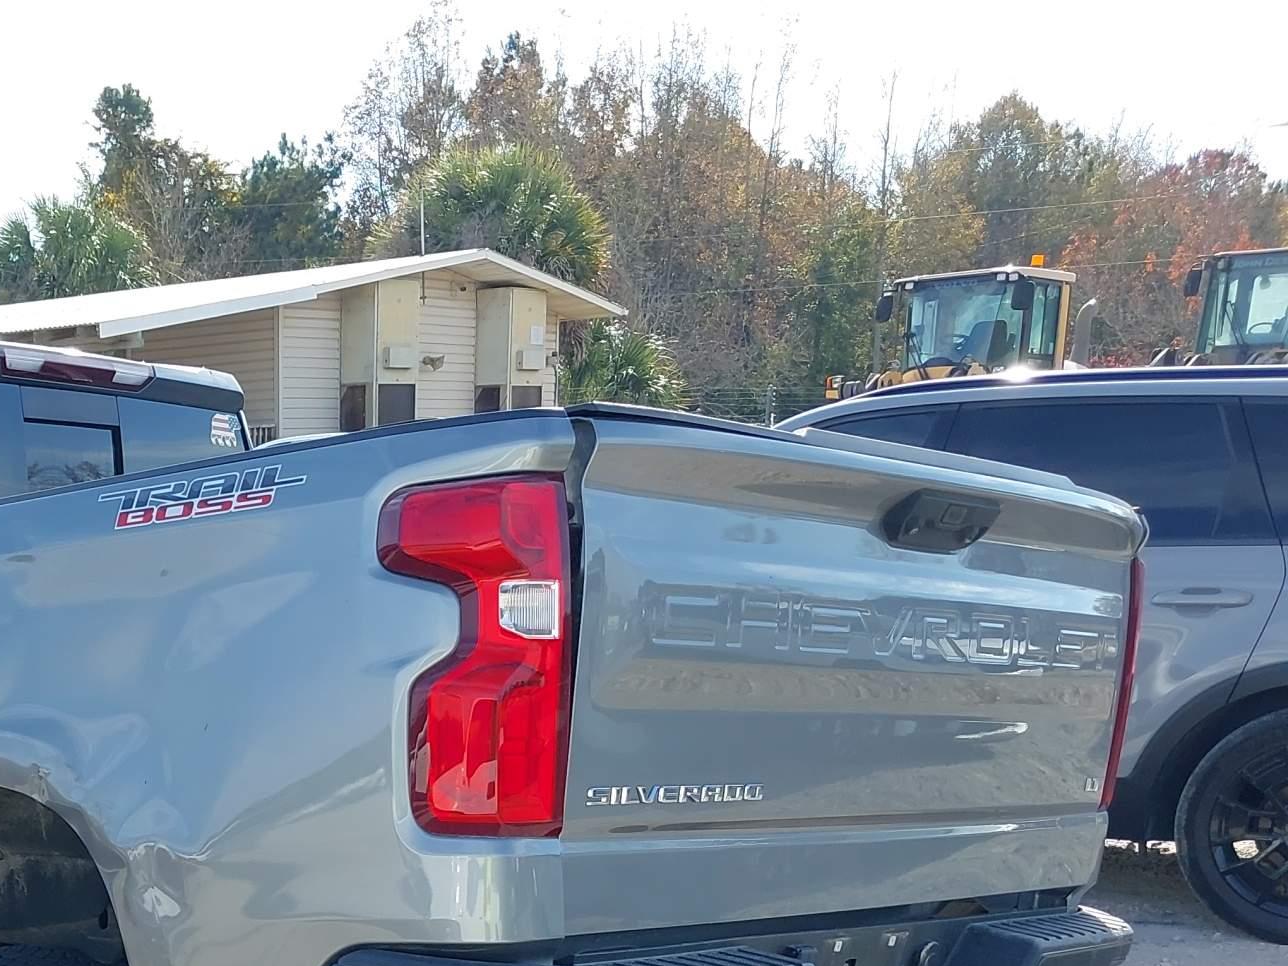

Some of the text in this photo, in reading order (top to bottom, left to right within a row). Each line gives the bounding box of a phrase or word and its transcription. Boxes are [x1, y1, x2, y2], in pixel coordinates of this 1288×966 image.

[98, 464, 307, 511] TRAIL
[114, 487, 276, 530] BOSS
[650, 592, 1117, 671] CHEVROLET
[585, 783, 764, 807] SILVERADO
